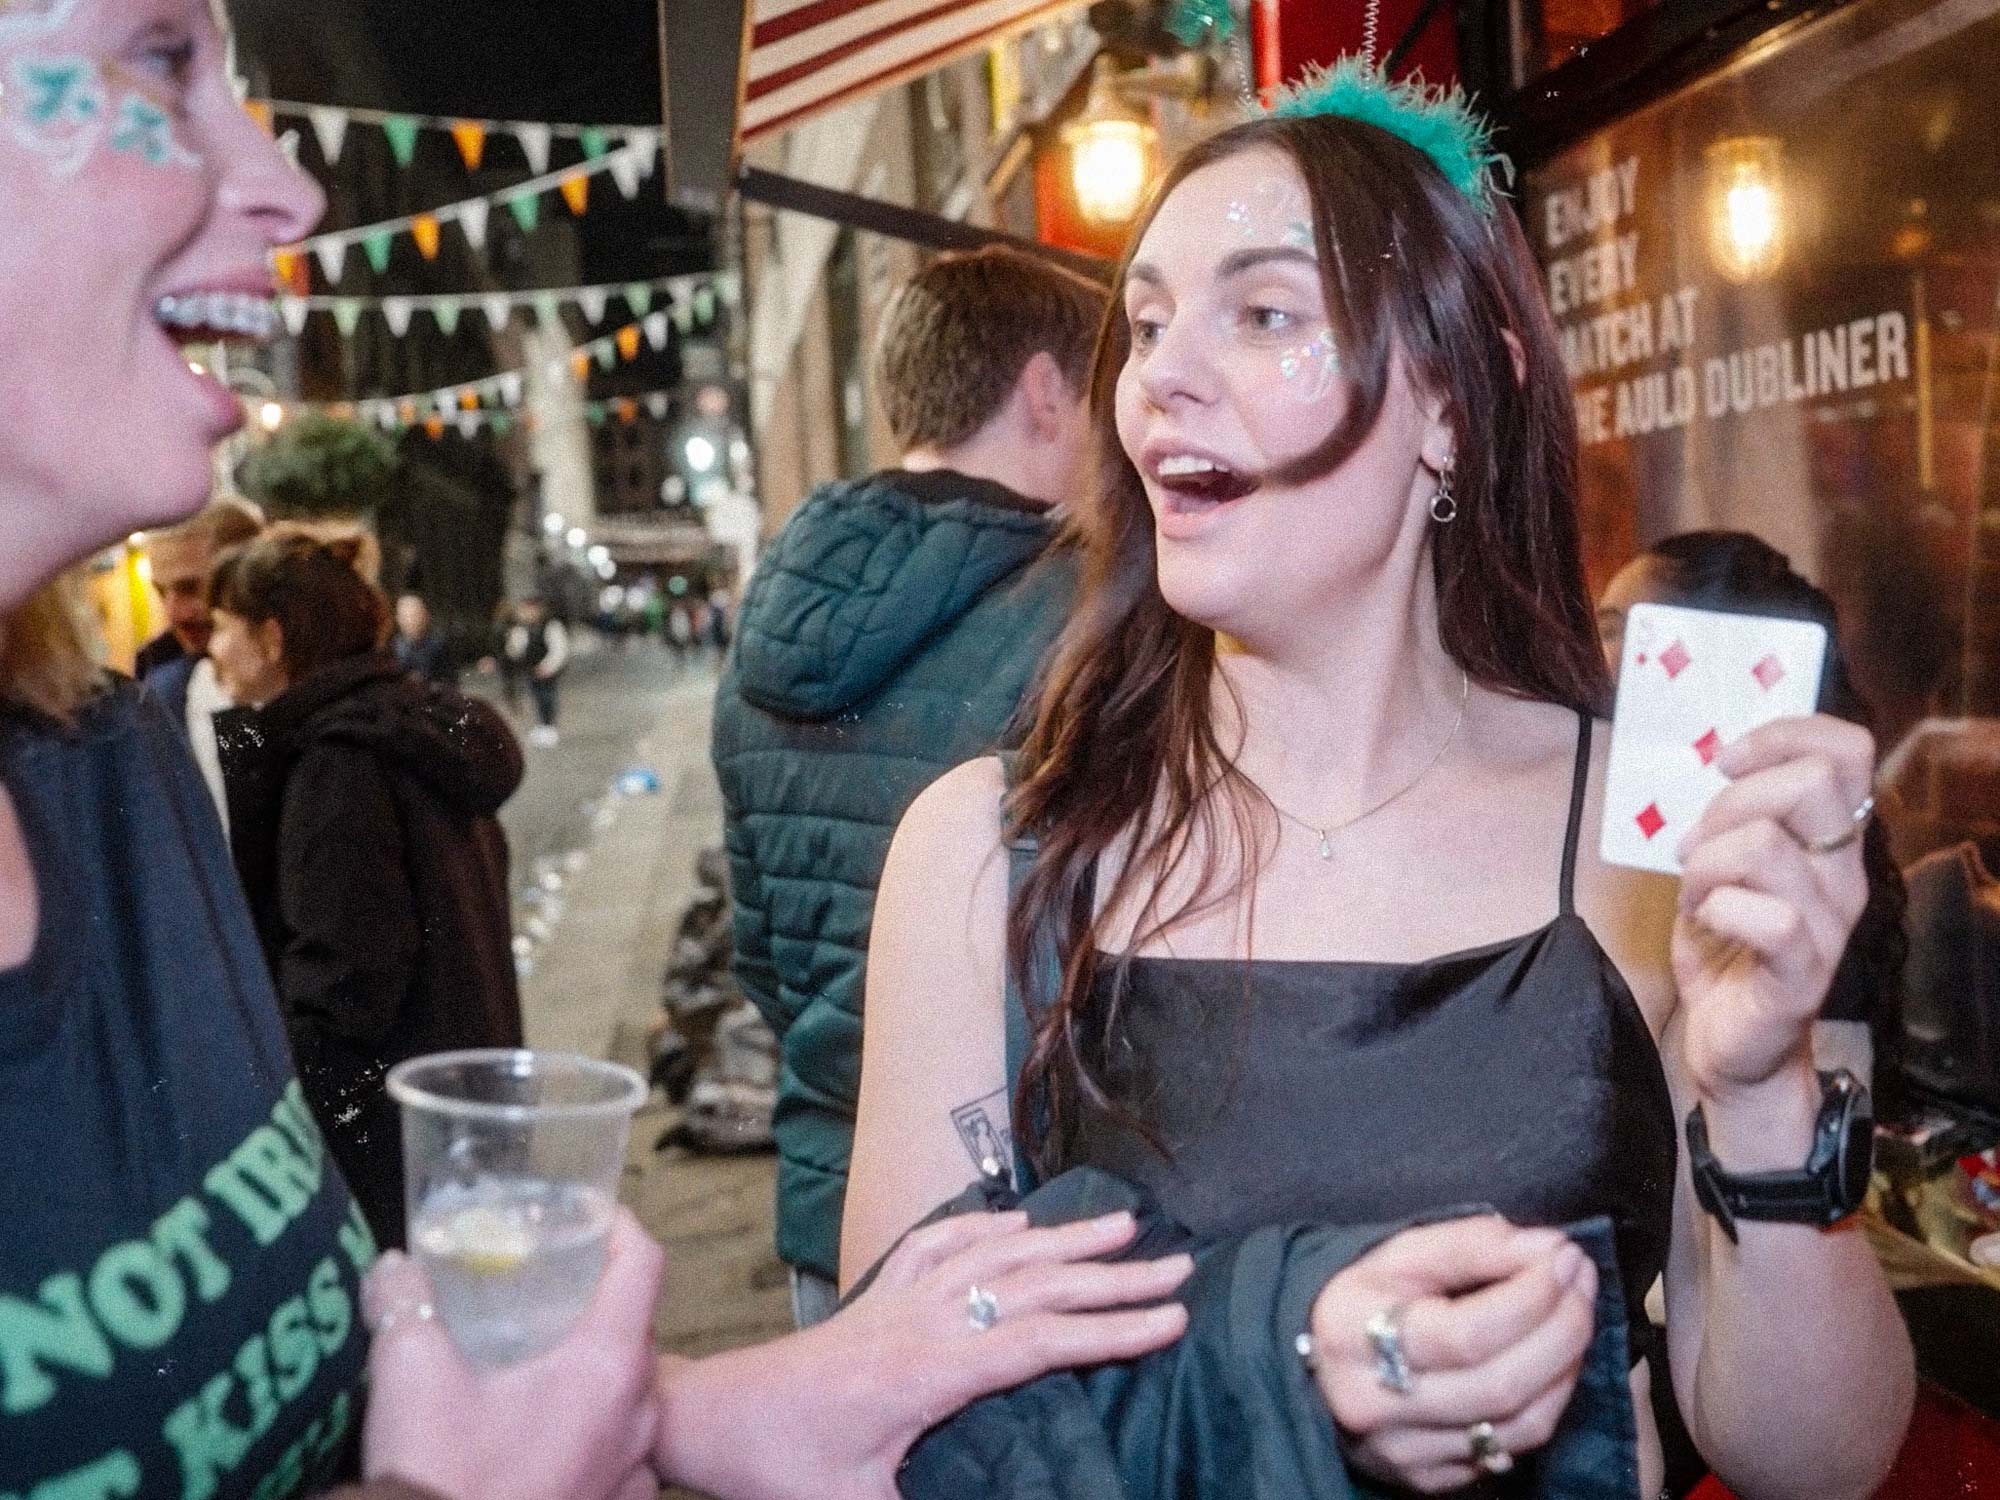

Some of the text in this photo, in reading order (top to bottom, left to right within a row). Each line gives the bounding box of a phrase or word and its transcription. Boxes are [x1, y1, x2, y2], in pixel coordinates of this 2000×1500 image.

[1546, 155, 1640, 247] ENJOY
[1549, 231, 1639, 314] EVERY
[1660, 285, 1698, 352] AT
[1573, 310, 1909, 444] HE AULD DUBLINER
[0, 1197, 232, 1413] NOT
[202, 1076, 325, 1245] IRI
[162, 1255, 352, 1500] KISS
